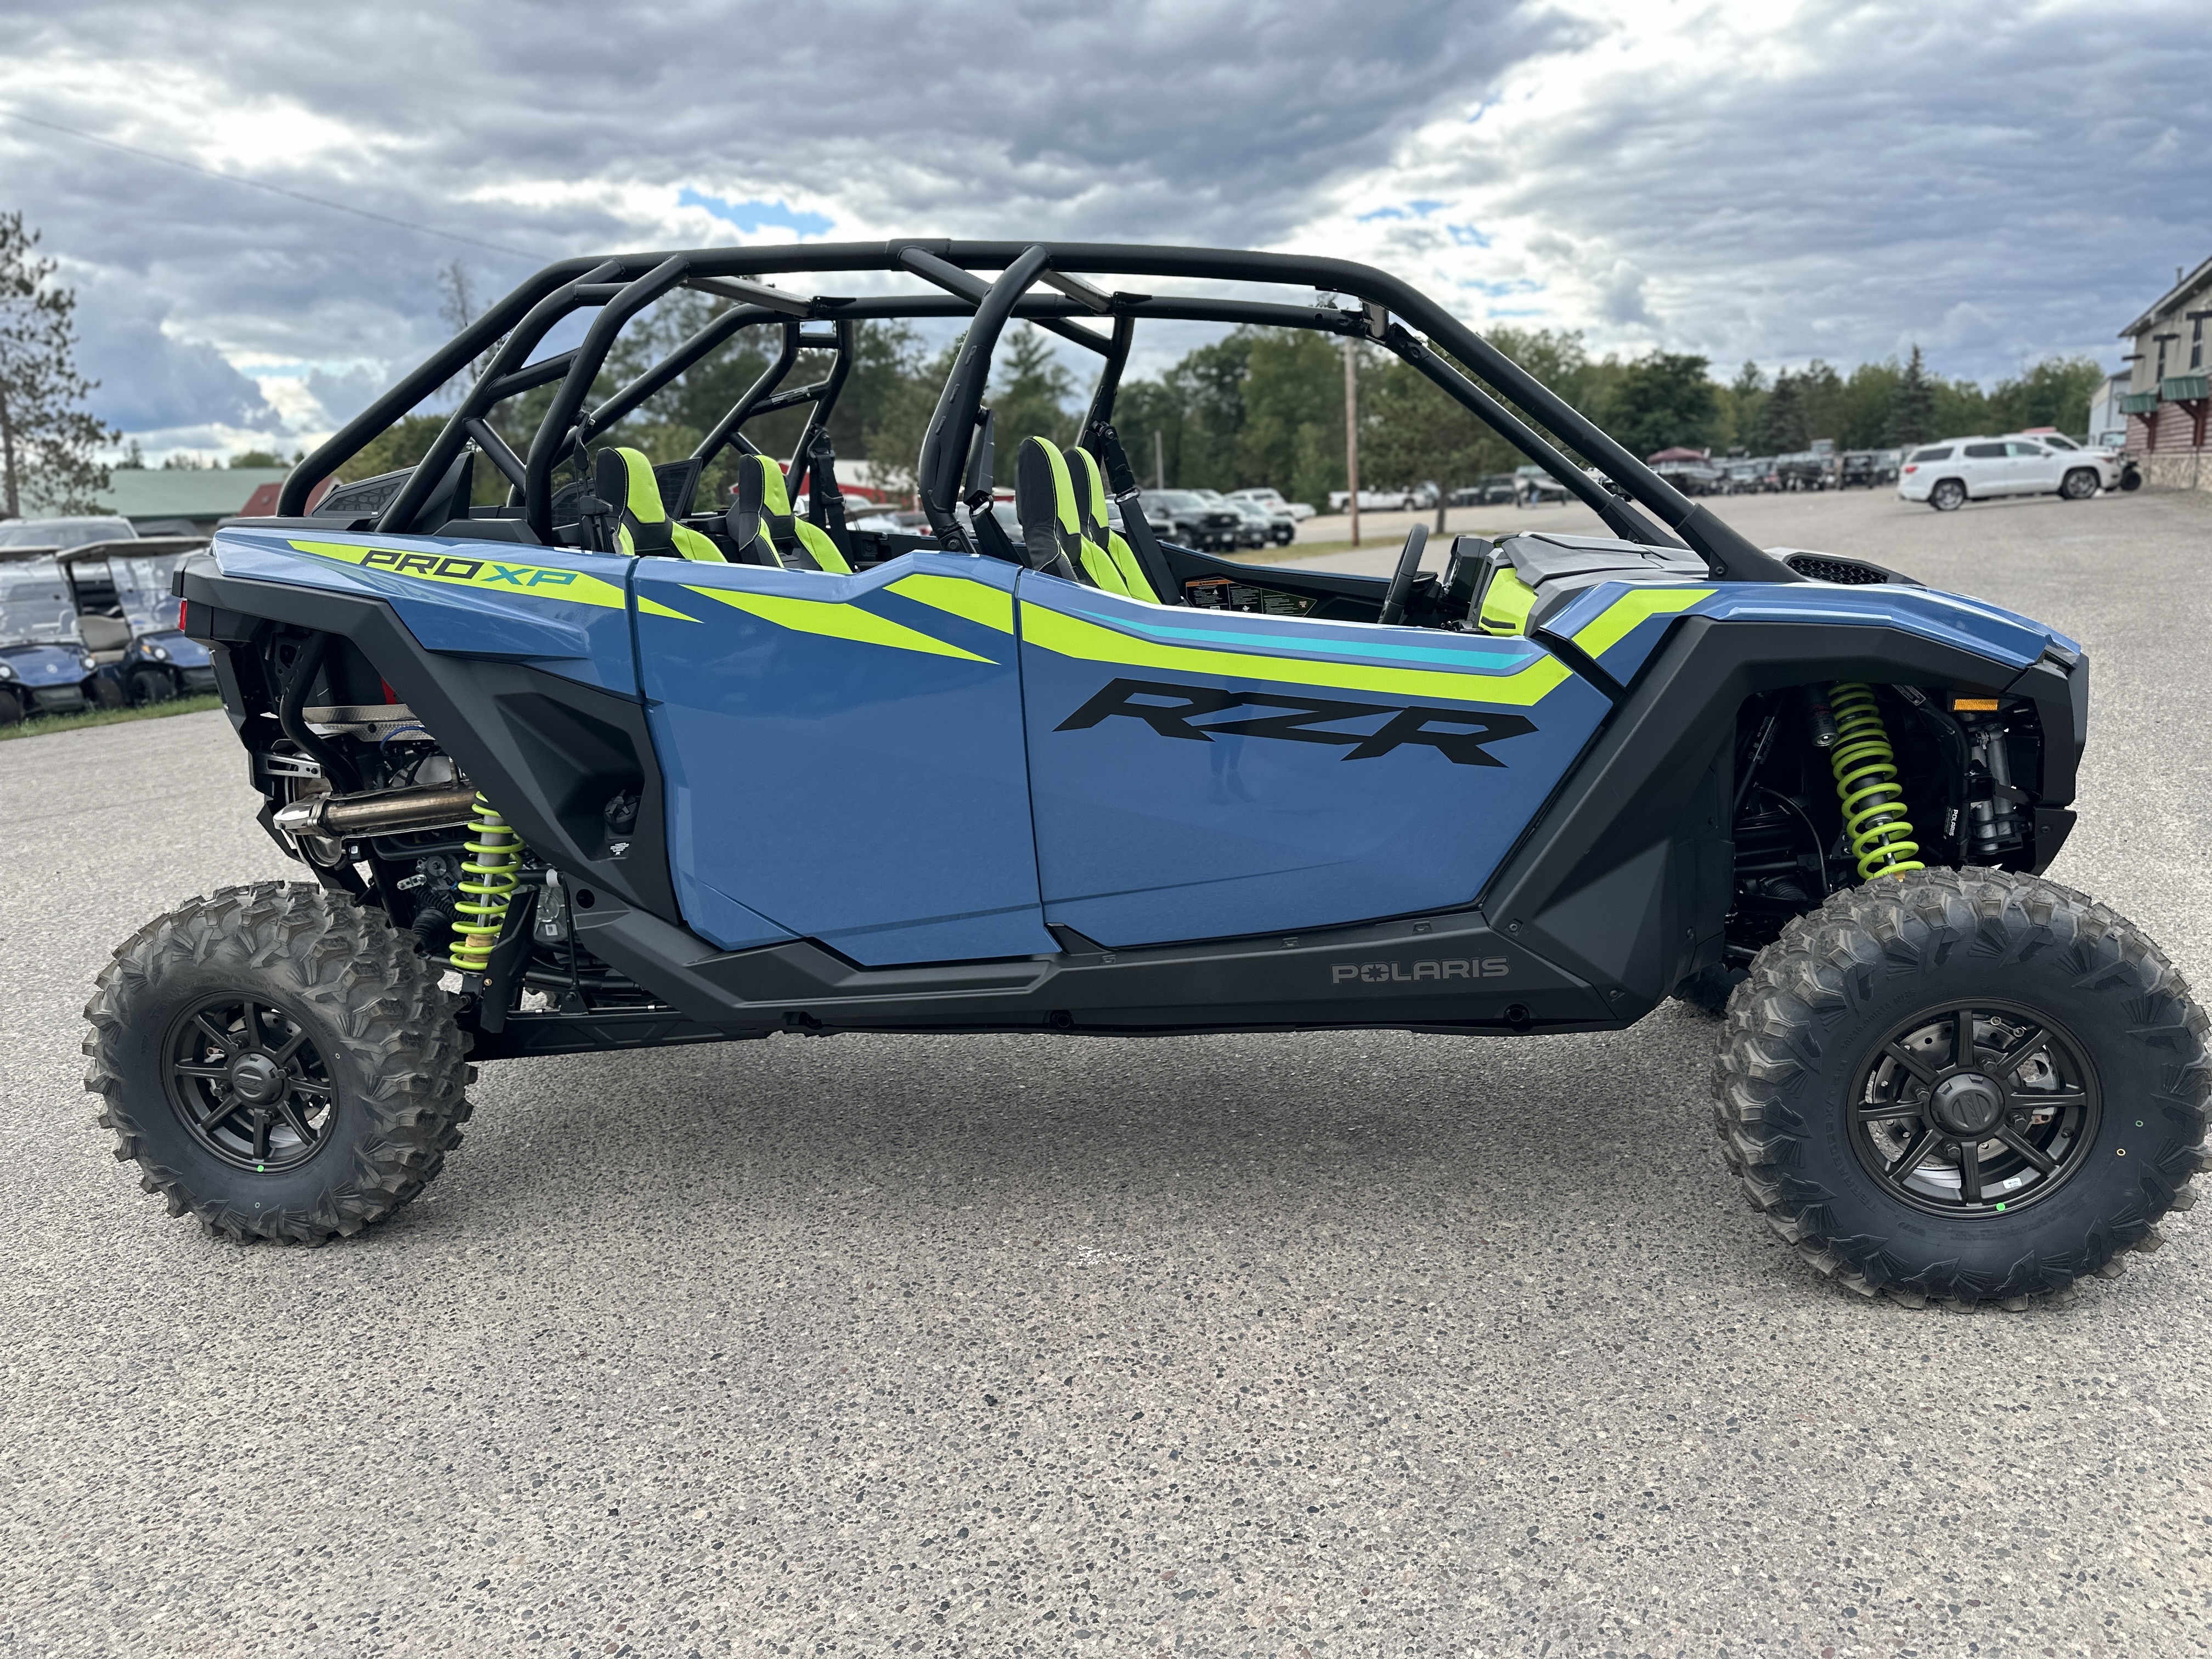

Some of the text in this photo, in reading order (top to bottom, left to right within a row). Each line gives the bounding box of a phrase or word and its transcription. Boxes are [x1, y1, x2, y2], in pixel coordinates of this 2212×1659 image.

[359, 550, 578, 586] PRO XP
[1051, 677, 1540, 768] RZR
[1949, 809, 1959, 837] POLARIS
[1331, 957, 1510, 984] POLARIS
